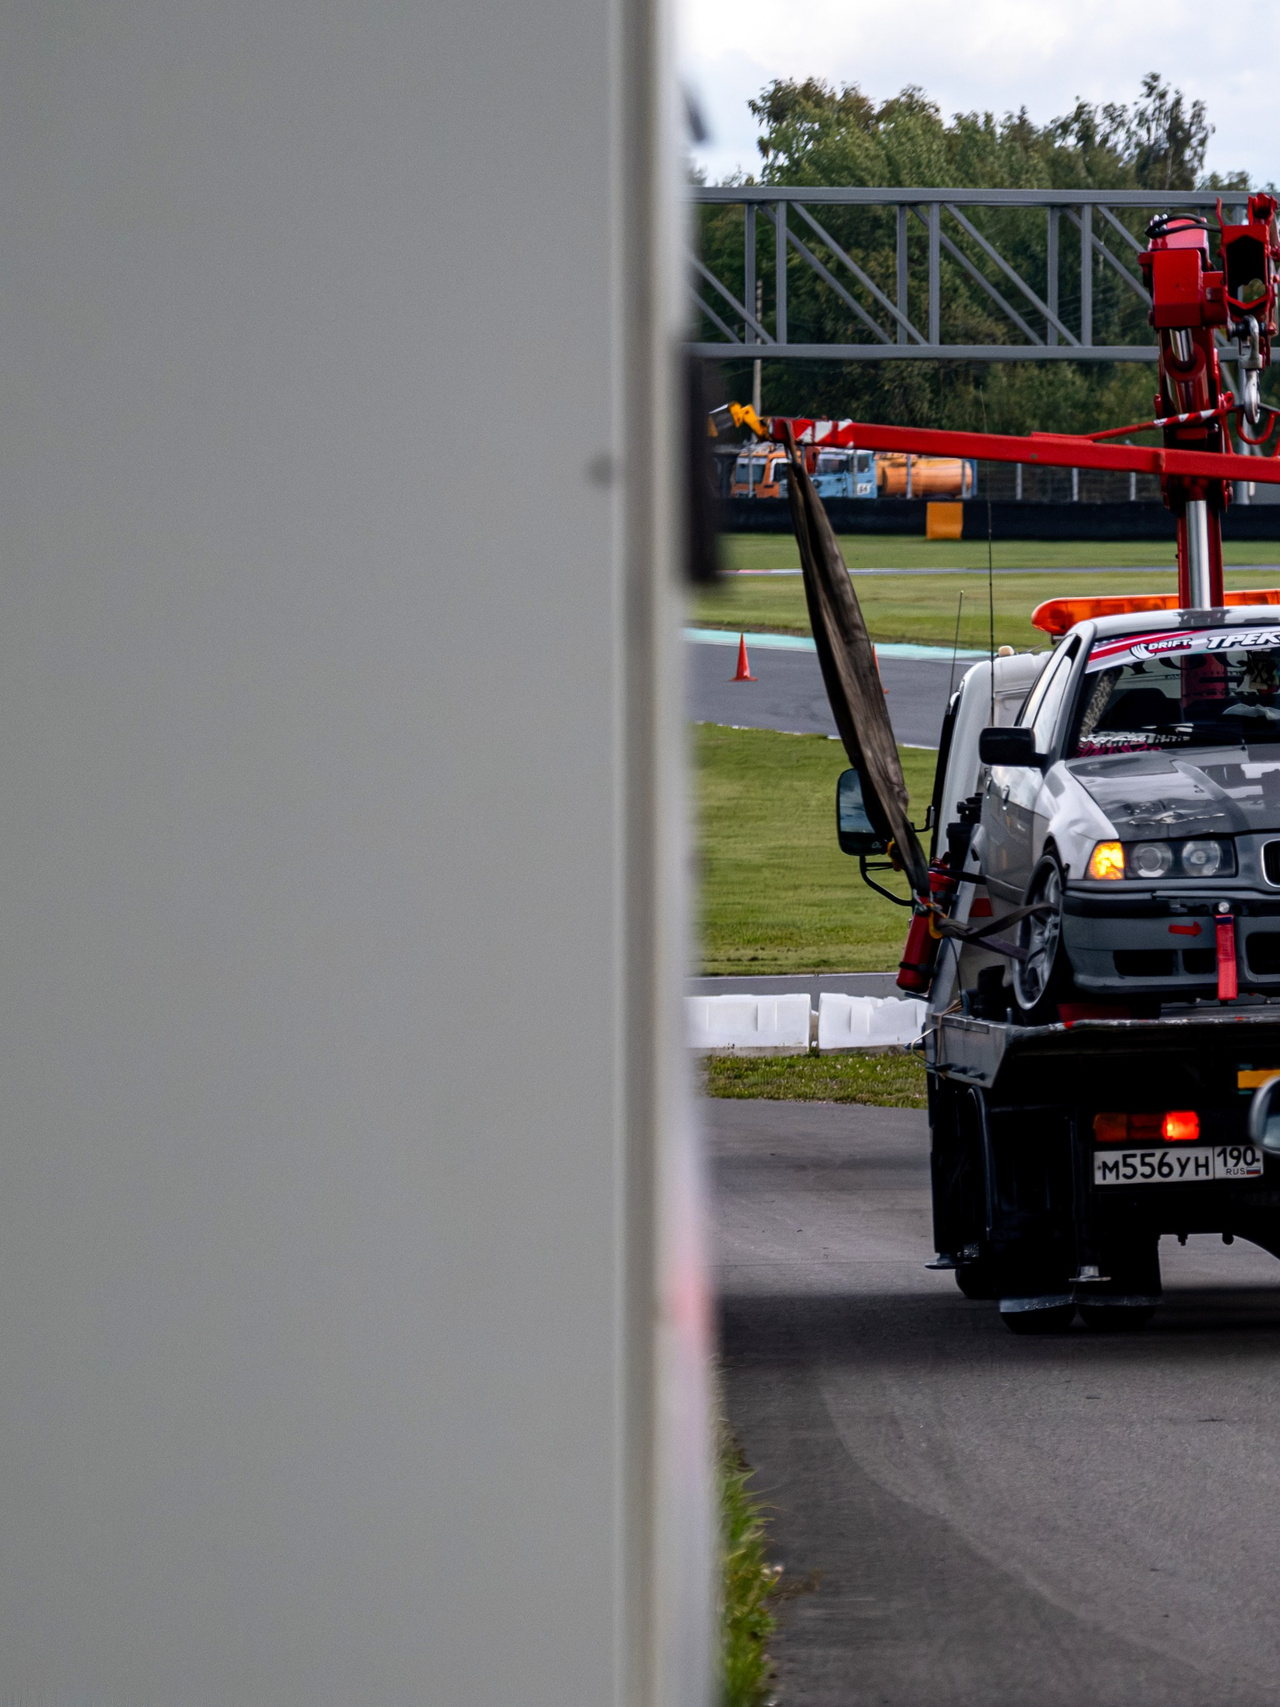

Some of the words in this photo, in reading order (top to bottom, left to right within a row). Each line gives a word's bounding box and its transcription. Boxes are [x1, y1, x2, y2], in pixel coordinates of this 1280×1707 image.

[1148, 638, 1191, 651] DRIFT
[1216, 1147, 1256, 1168] 190
[1226, 1167, 1246, 1176] RUS
